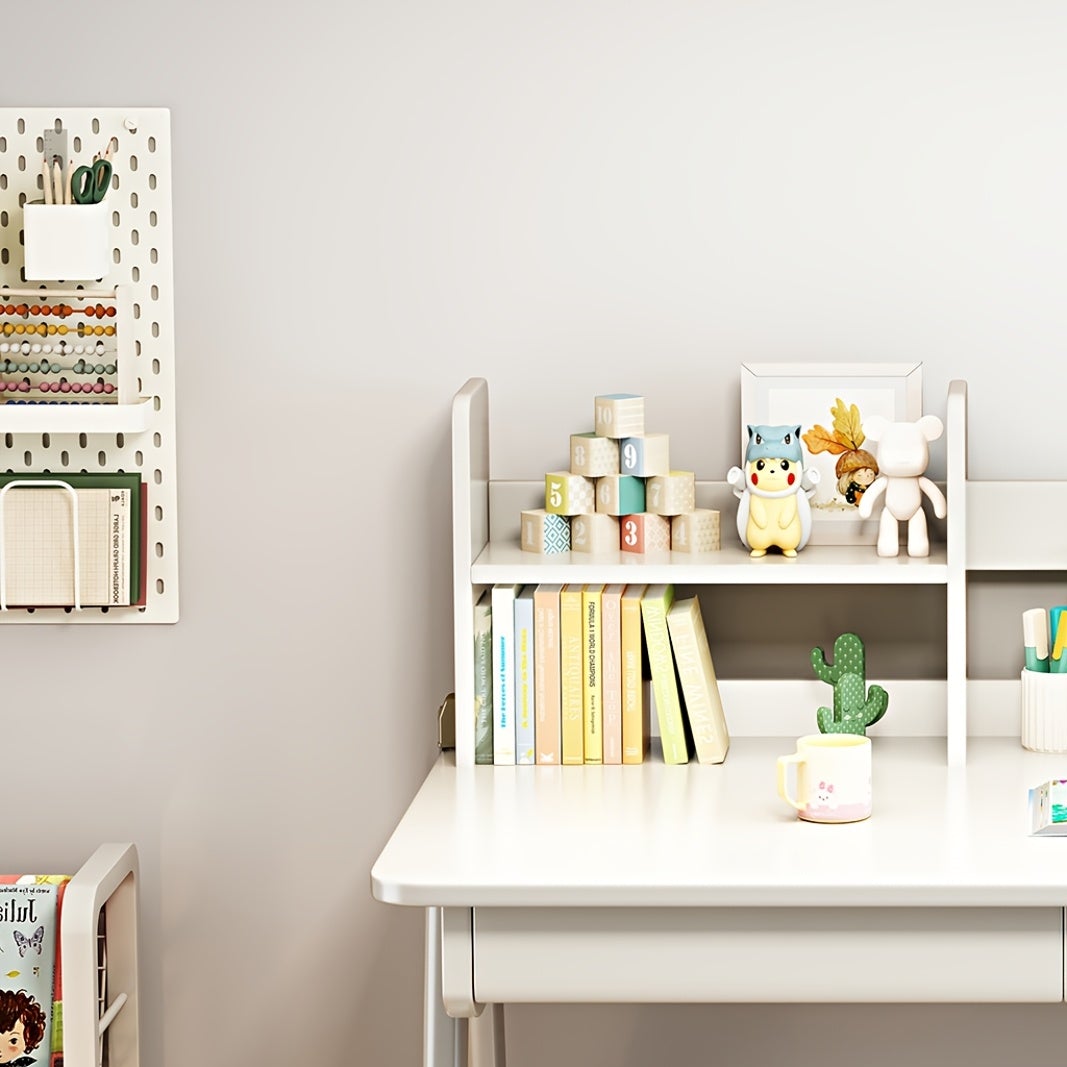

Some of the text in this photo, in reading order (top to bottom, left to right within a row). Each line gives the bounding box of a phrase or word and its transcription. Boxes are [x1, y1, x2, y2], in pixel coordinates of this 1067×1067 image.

[597, 406, 612, 424] 10
[575, 445, 586, 467] 8
[624, 443, 637, 469] 9
[550, 482, 562, 507] 5
[600, 484, 611, 504] 6
[651, 483, 662, 507] 7
[526, 520, 534, 545] 1
[575, 522, 586, 545] 2
[624, 520, 638, 546] 3
[676, 522, 687, 545] 4
[588, 601, 596, 628] FORMULA
[588, 633, 596, 654] WORLD
[588, 655, 596, 688] CHAMPIONS
